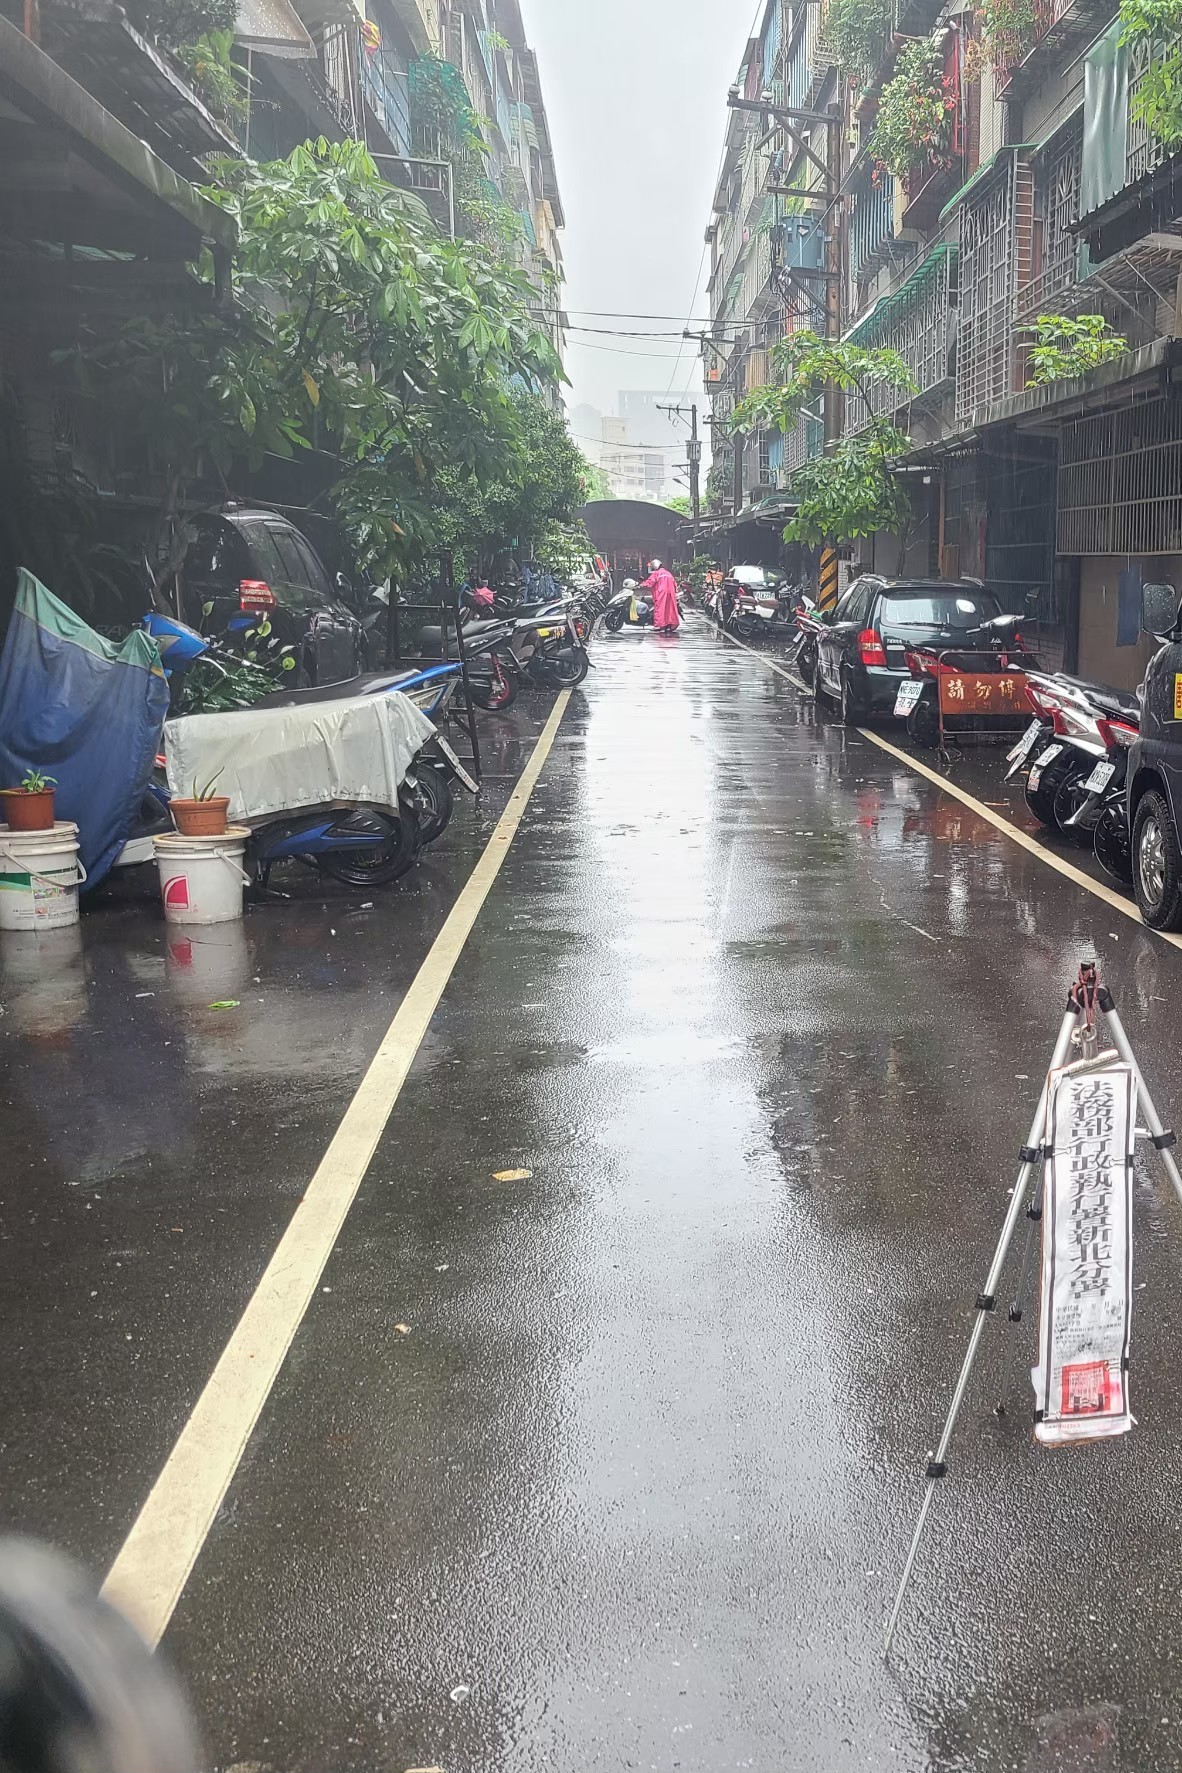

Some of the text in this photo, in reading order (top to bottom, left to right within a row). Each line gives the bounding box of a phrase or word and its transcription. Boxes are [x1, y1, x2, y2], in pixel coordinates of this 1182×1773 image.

[1069, 1081, 1114, 1299] 法務部行政執行署新北分署
